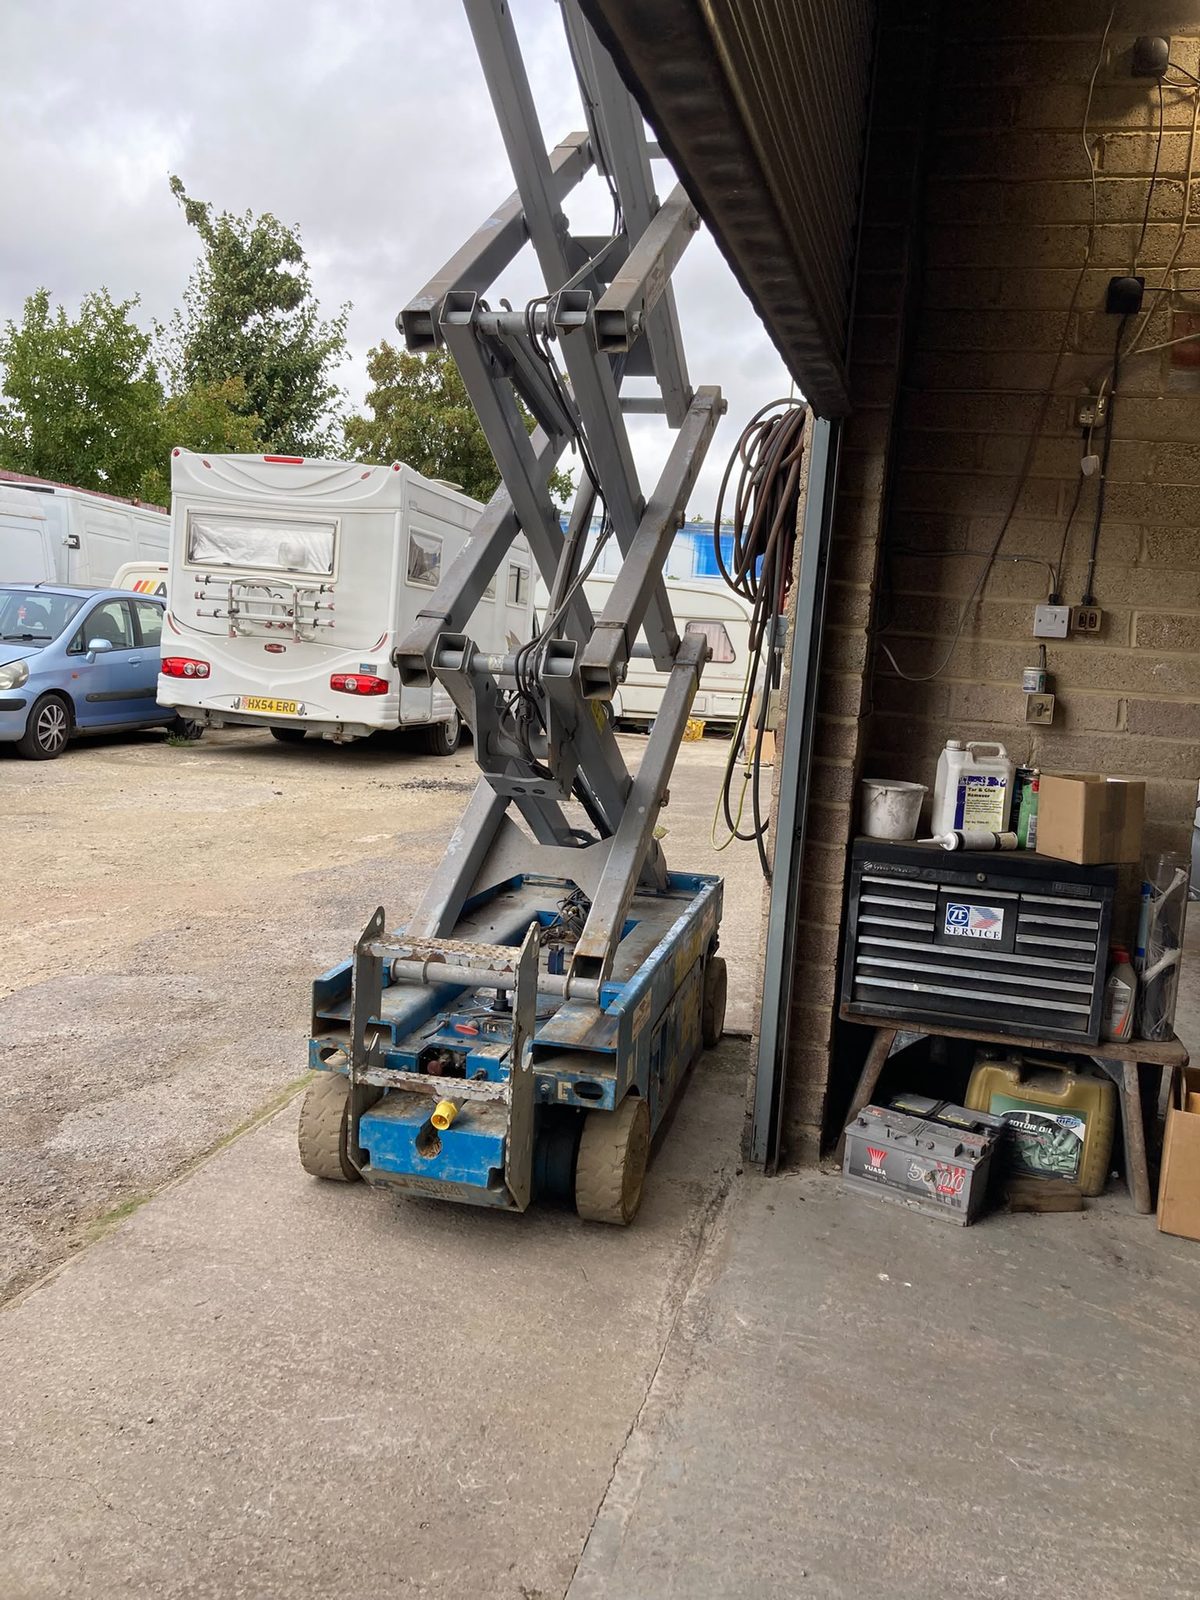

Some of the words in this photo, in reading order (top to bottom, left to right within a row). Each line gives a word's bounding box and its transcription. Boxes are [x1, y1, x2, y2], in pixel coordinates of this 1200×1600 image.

[247, 698, 273, 710] HX54
[949, 909, 968, 922] ZF
[945, 926, 1000, 939] SERVICE
[1039, 1125, 1054, 1135] OIL
[863, 1163, 887, 1176] YUASA
